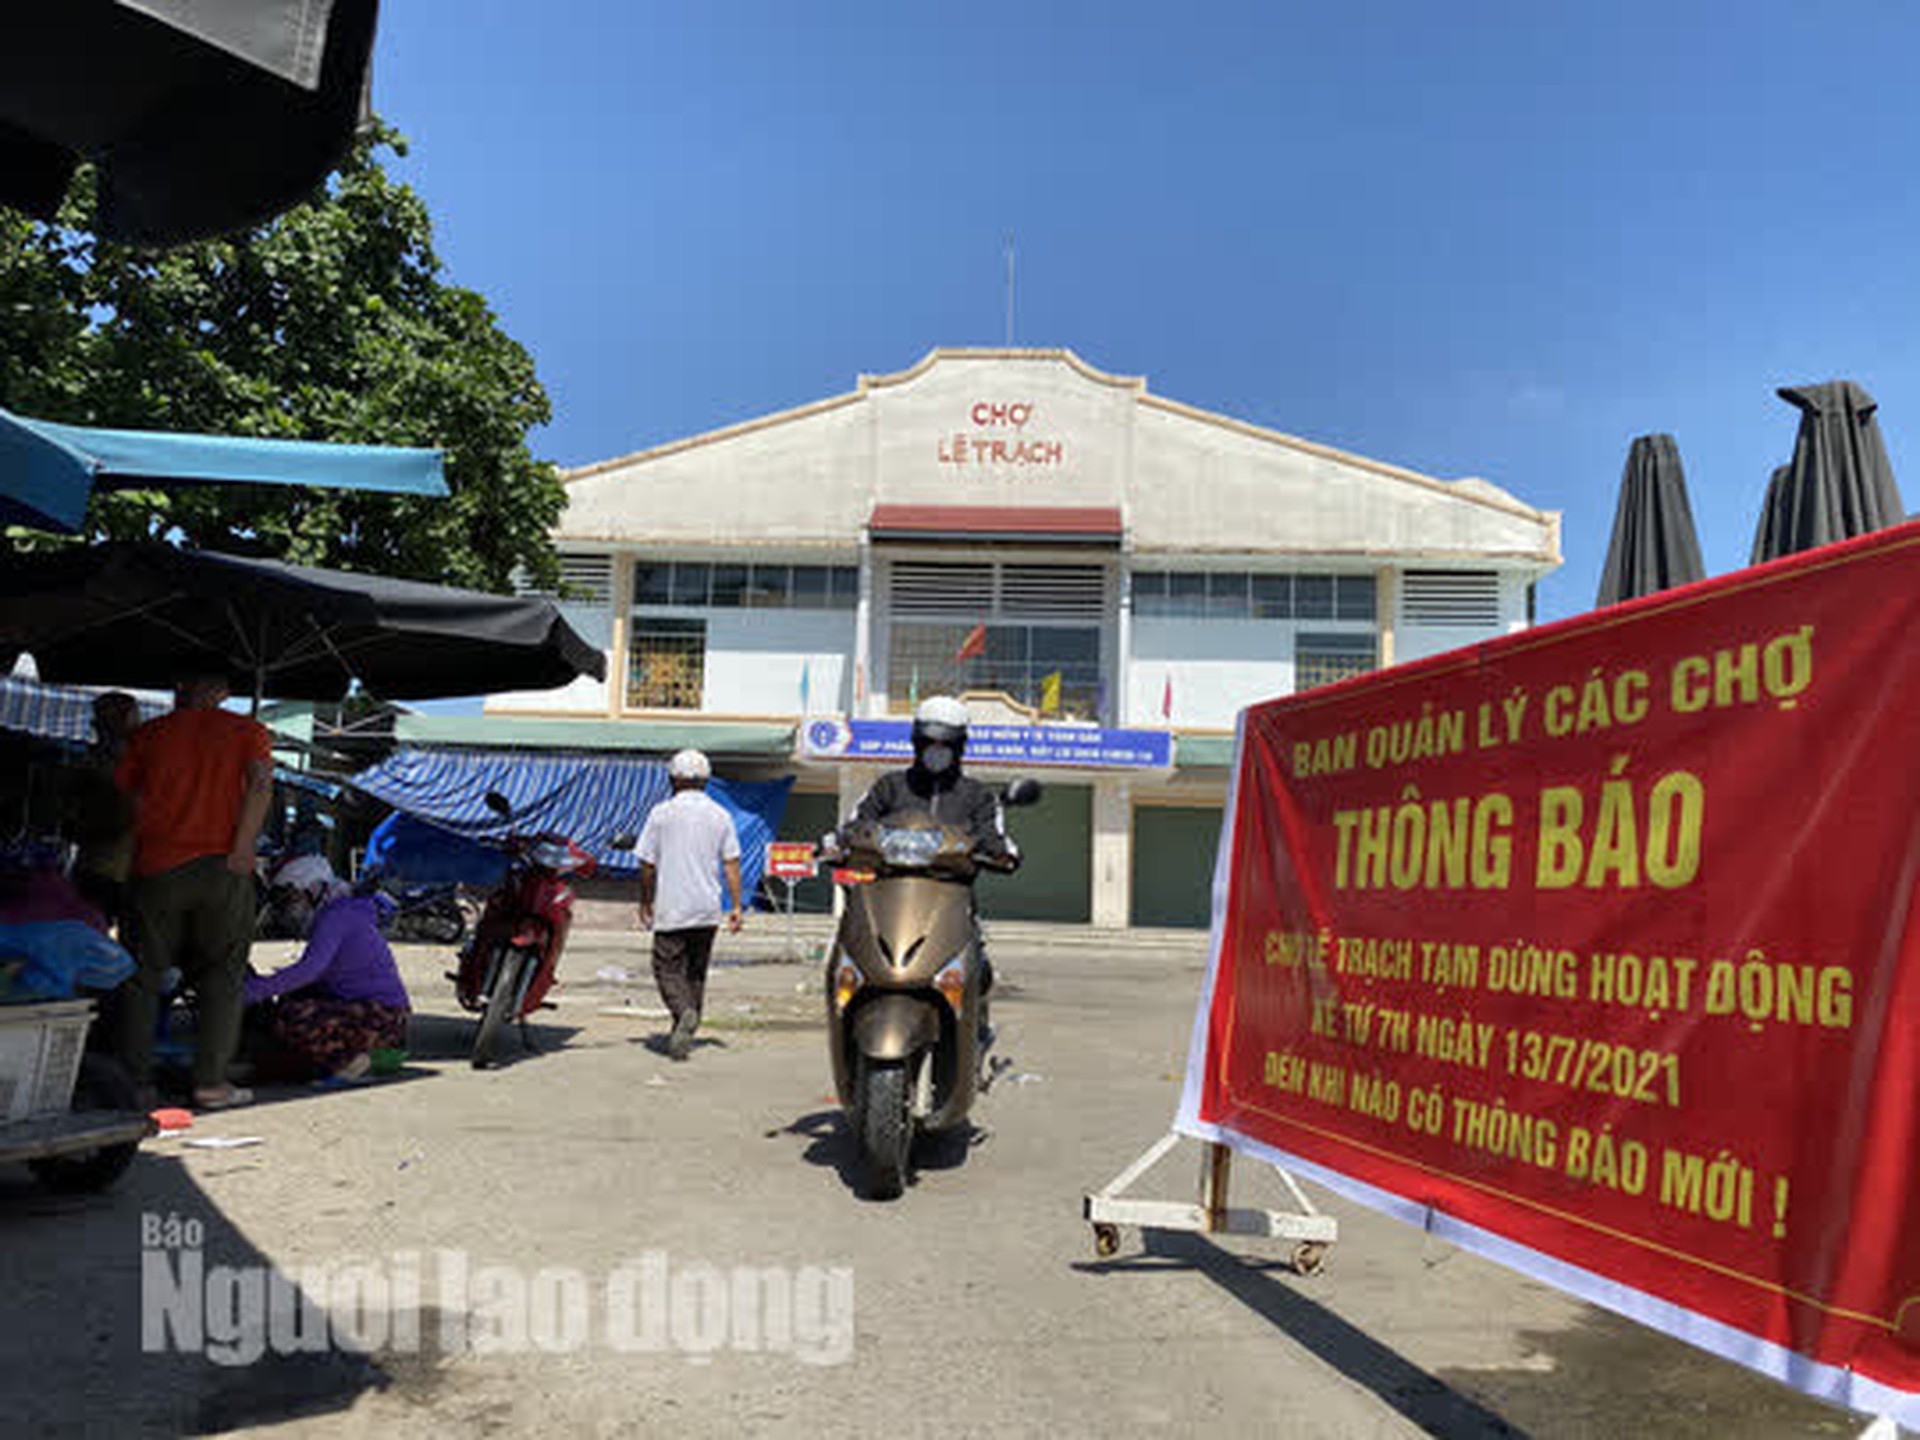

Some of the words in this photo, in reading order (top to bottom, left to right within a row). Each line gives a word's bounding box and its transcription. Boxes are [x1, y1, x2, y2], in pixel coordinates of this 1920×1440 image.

[971, 402, 1034, 433] CHỢ
[971, 439, 1063, 467] TRẠCH
[1293, 729, 1357, 779] BAN
[1366, 703, 1465, 770] QUẢN
[1477, 686, 1528, 749] LÝ
[1544, 667, 1650, 736] CÁC
[1671, 625, 1815, 712] CHỢ
[1333, 784, 1514, 891] THÔNG
[1535, 754, 1705, 889] BÁO
[1337, 936, 1413, 987] TRẠCH
[1421, 941, 1479, 995] TẠM
[1590, 952, 1698, 1021] HOẠT
[1705, 949, 1854, 1032] ĐỘNG
[1377, 1008, 1411, 1052] 7H
[1417, 1010, 1495, 1069] NGÀY
[1505, 1028, 1680, 1107] 13/7/2021
[1308, 1060, 1346, 1108] KHI
[1350, 1068, 1401, 1123] NÀO
[1407, 1082, 1444, 1135] CÓ
[1453, 1095, 1557, 1168] THÔNG
[1566, 1122, 1648, 1196] BÁO
[1661, 1149, 1753, 1228] MỚI
